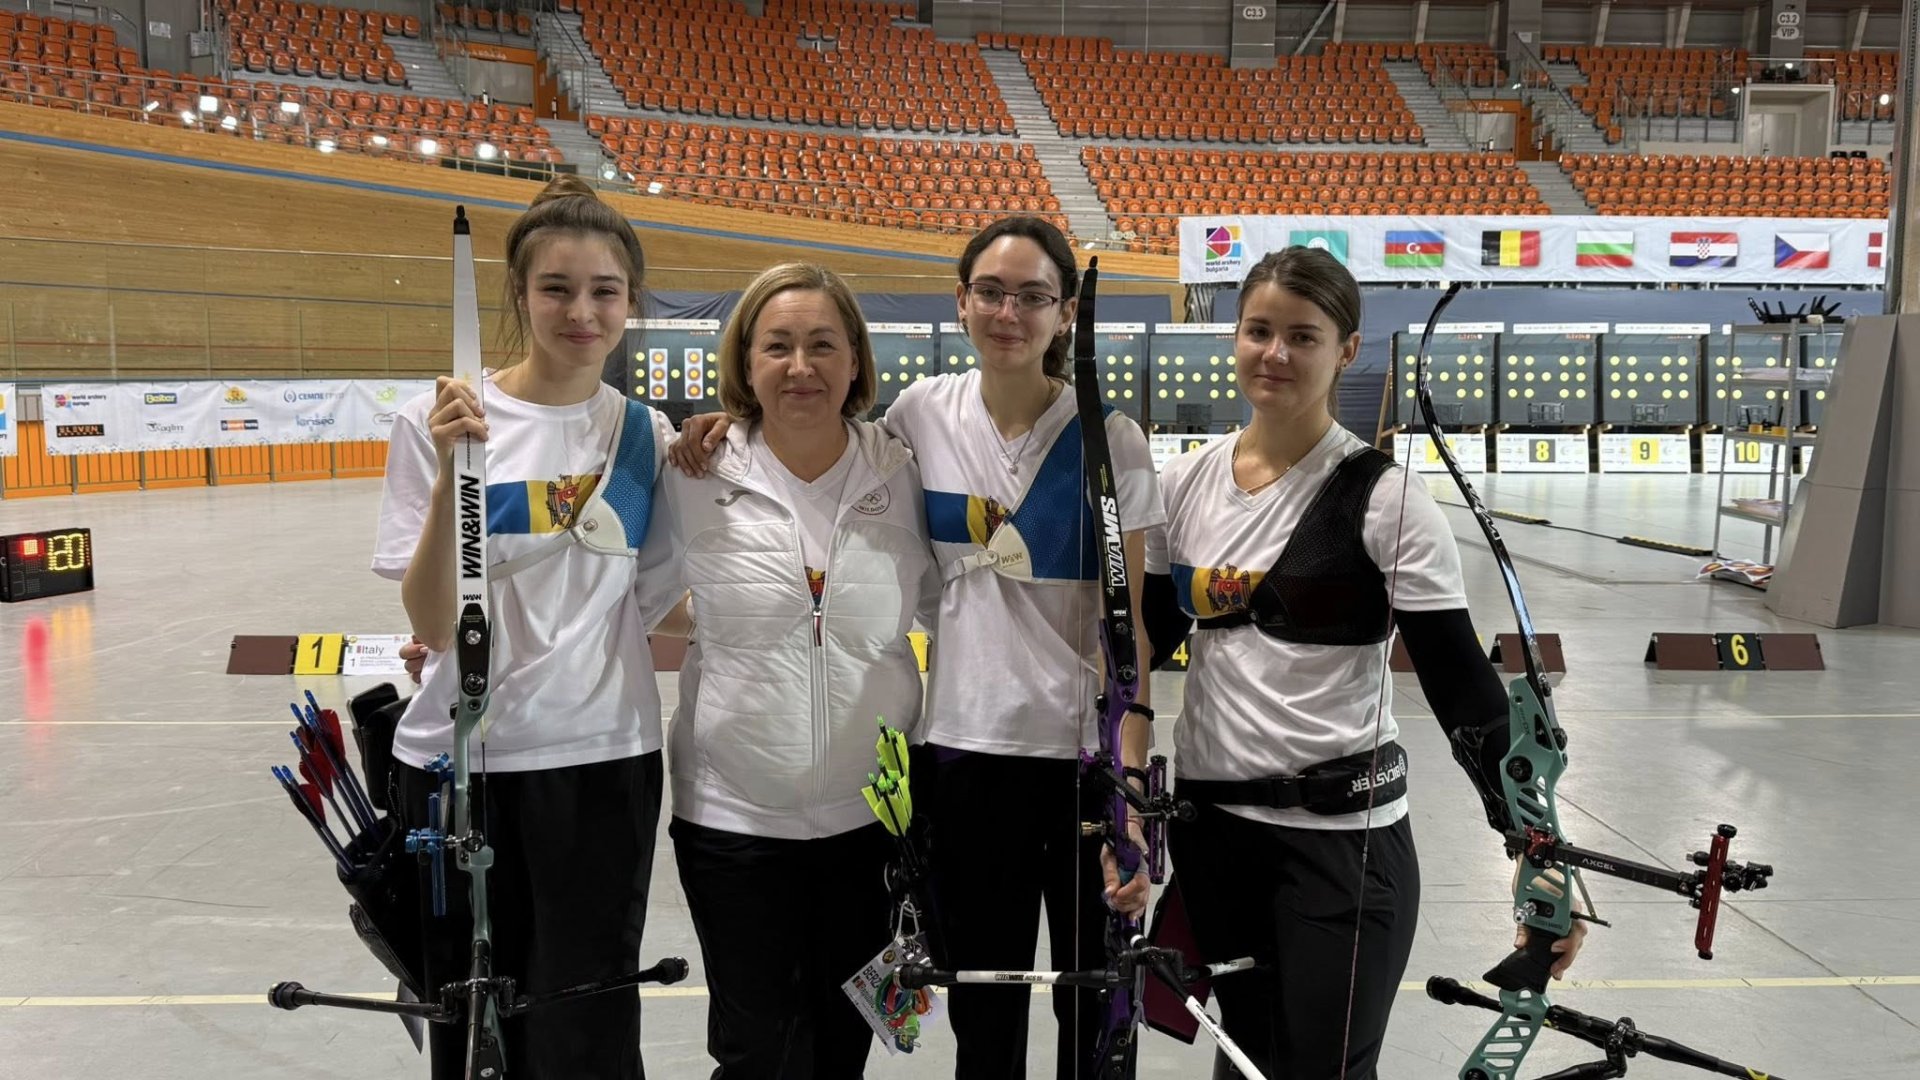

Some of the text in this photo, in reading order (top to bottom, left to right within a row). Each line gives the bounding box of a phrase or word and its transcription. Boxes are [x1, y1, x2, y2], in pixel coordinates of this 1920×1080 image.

[1780, 14, 1798, 24] C3.2
[1781, 28, 1796, 37] VIP
[1536, 440, 1549, 462] 8
[1640, 441, 1650, 461] 9
[1735, 441, 1759, 462] 10
[460, 474, 481, 579] WIN&WIN
[1101, 495, 1126, 587] WIAWIS
[311, 636, 323, 669] 1
[362, 645, 385, 656] Italy
[1172, 640, 1189, 667] 4
[1731, 634, 1749, 665] 6
[350, 658, 356, 668] 1
[1357, 760, 1396, 778] ARCHRY
[1582, 858, 1617, 871] AXCEL
